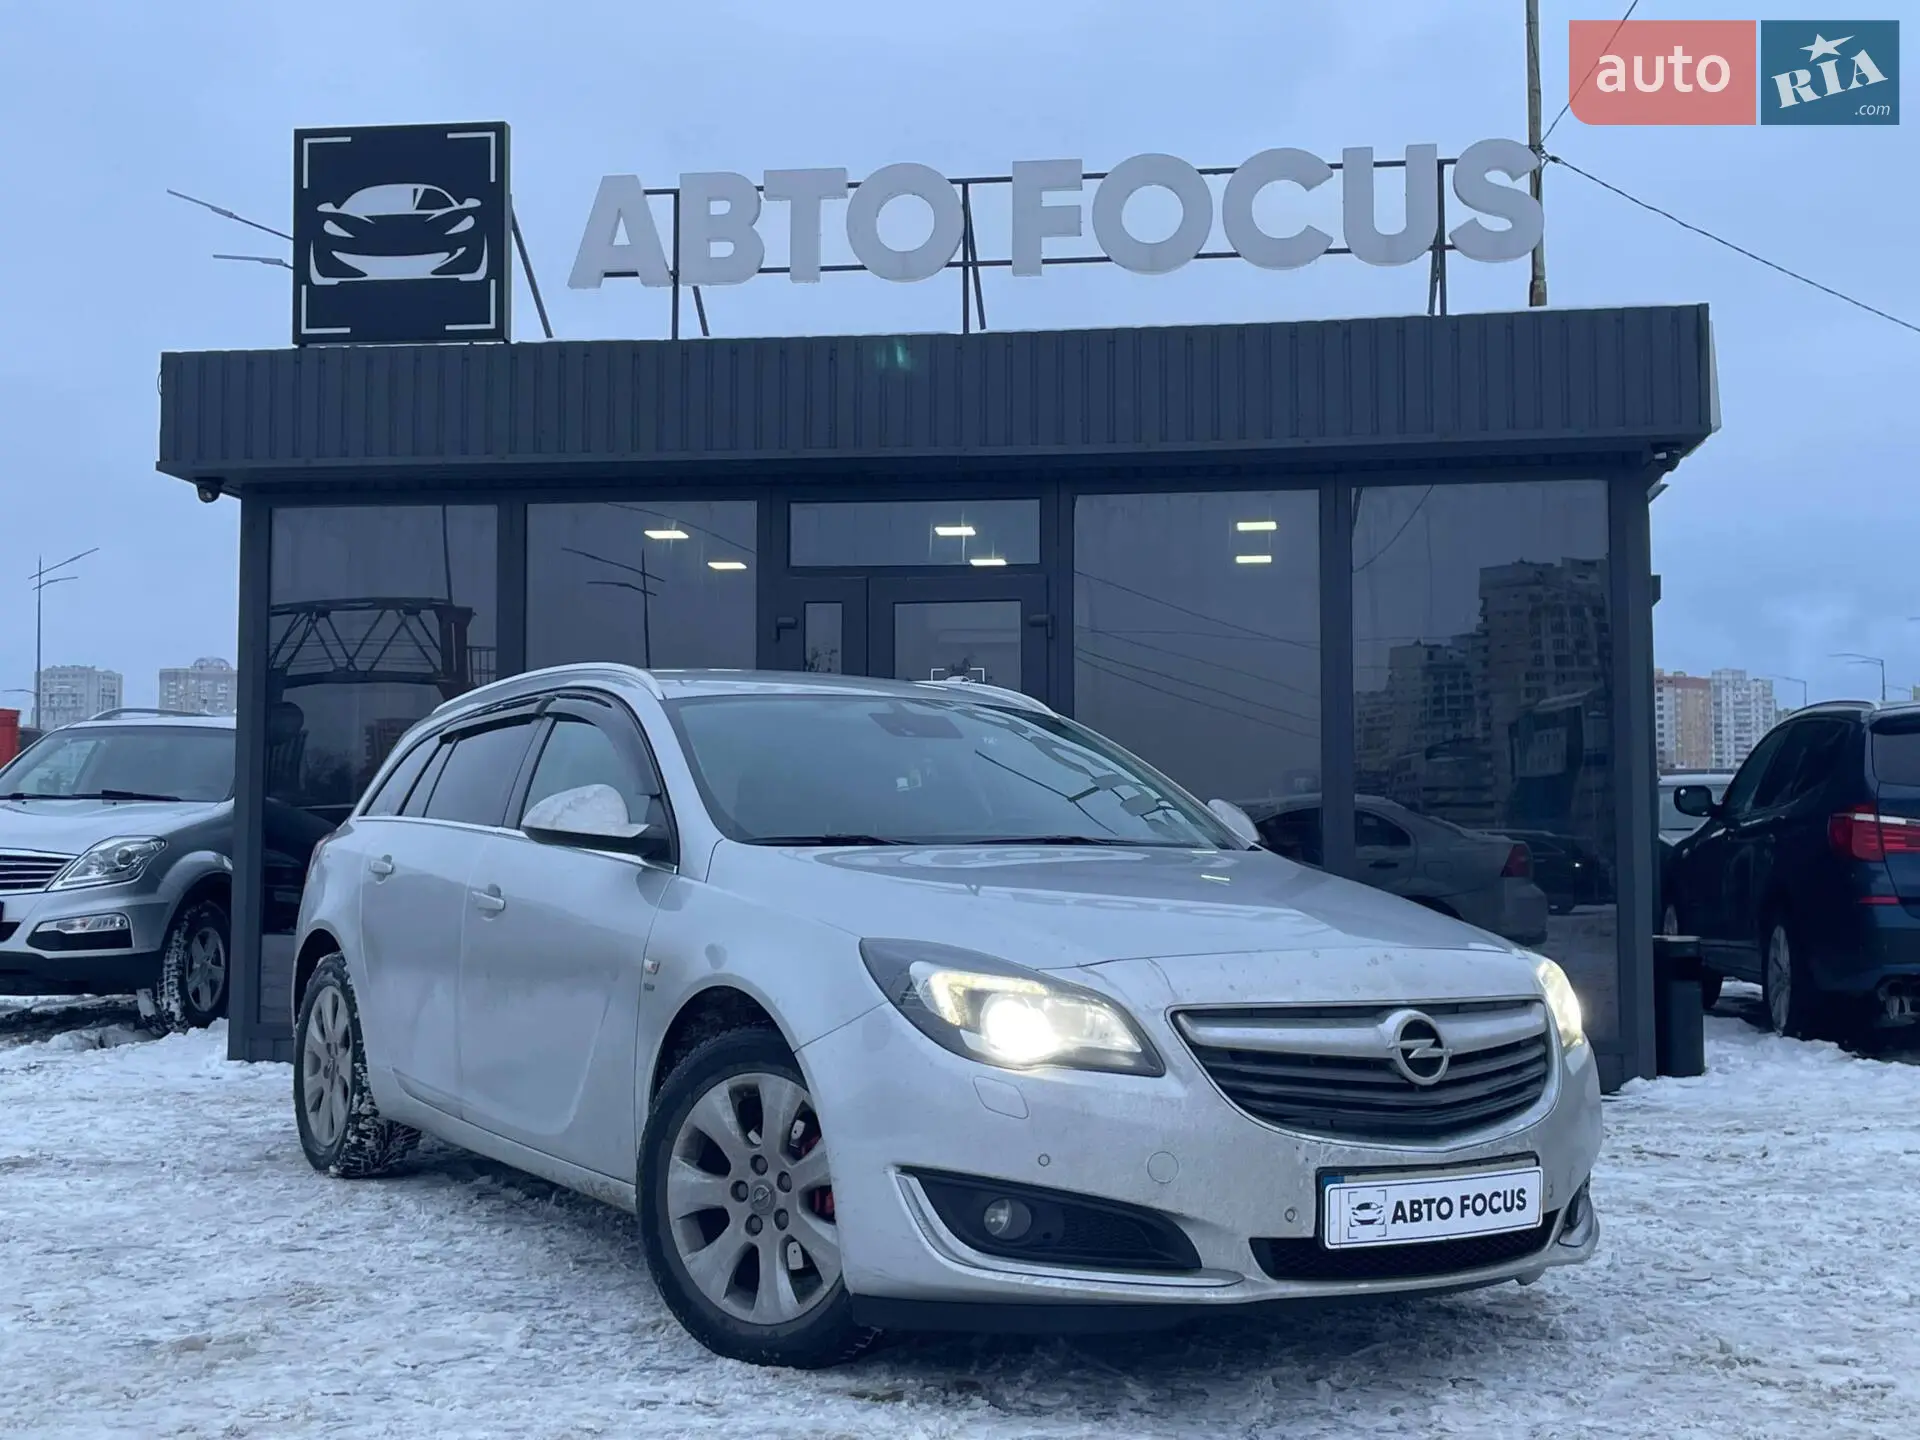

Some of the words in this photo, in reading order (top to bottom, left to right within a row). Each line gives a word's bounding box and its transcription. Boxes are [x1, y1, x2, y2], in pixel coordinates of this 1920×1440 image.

[567, 162, 965, 288] АВТО
[1012, 138, 1544, 277] FOCUS
[1390, 1196, 1453, 1225] АВТО
[1460, 1187, 1527, 1218] FOCUS
